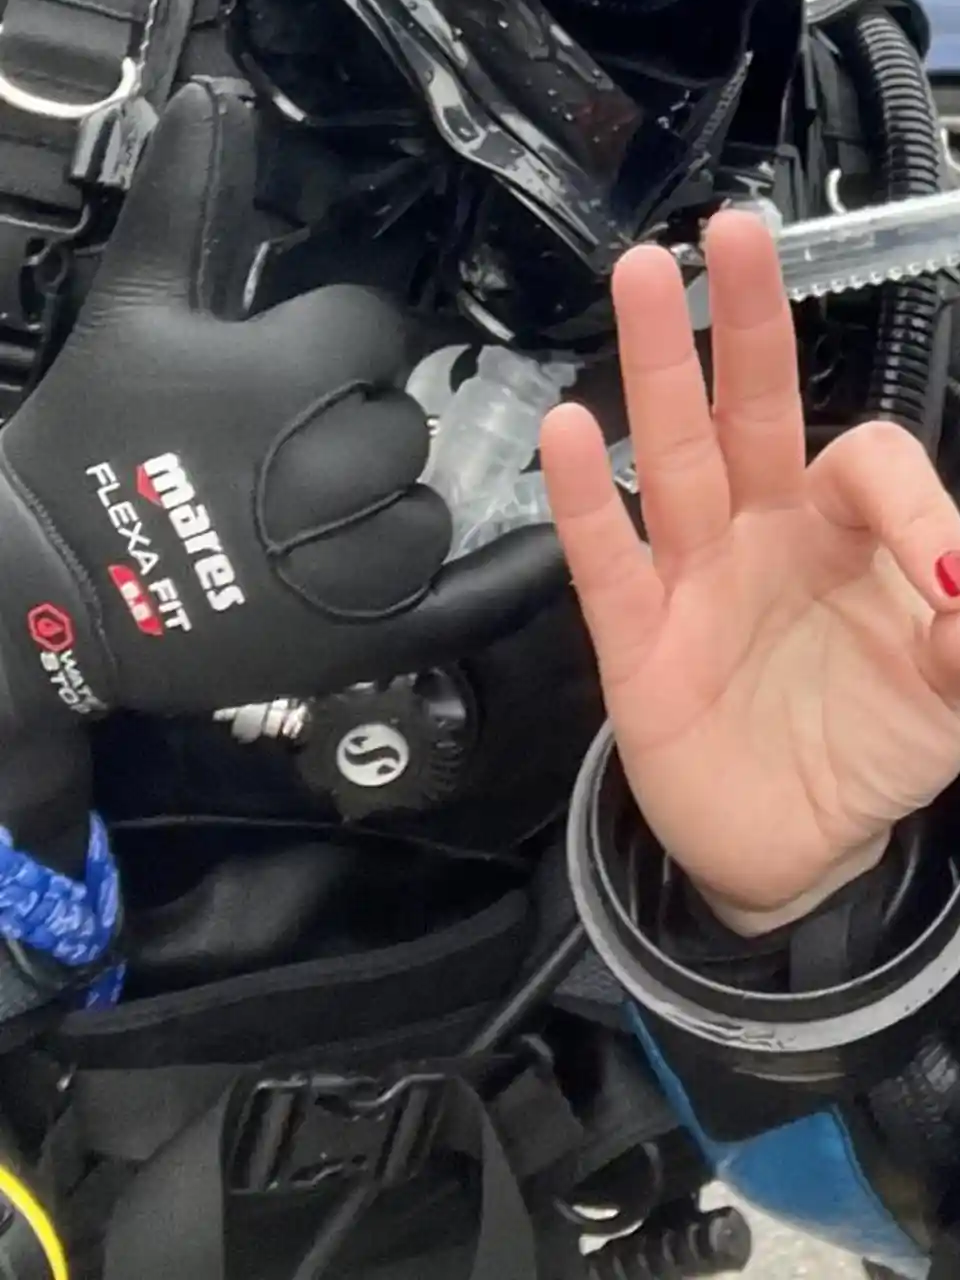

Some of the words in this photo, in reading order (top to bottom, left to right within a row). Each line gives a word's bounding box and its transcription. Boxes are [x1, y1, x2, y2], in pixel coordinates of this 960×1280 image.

[86, 462, 160, 575] FLEXA
[149, 578, 192, 631] FIT
[143, 452, 246, 612] mares
